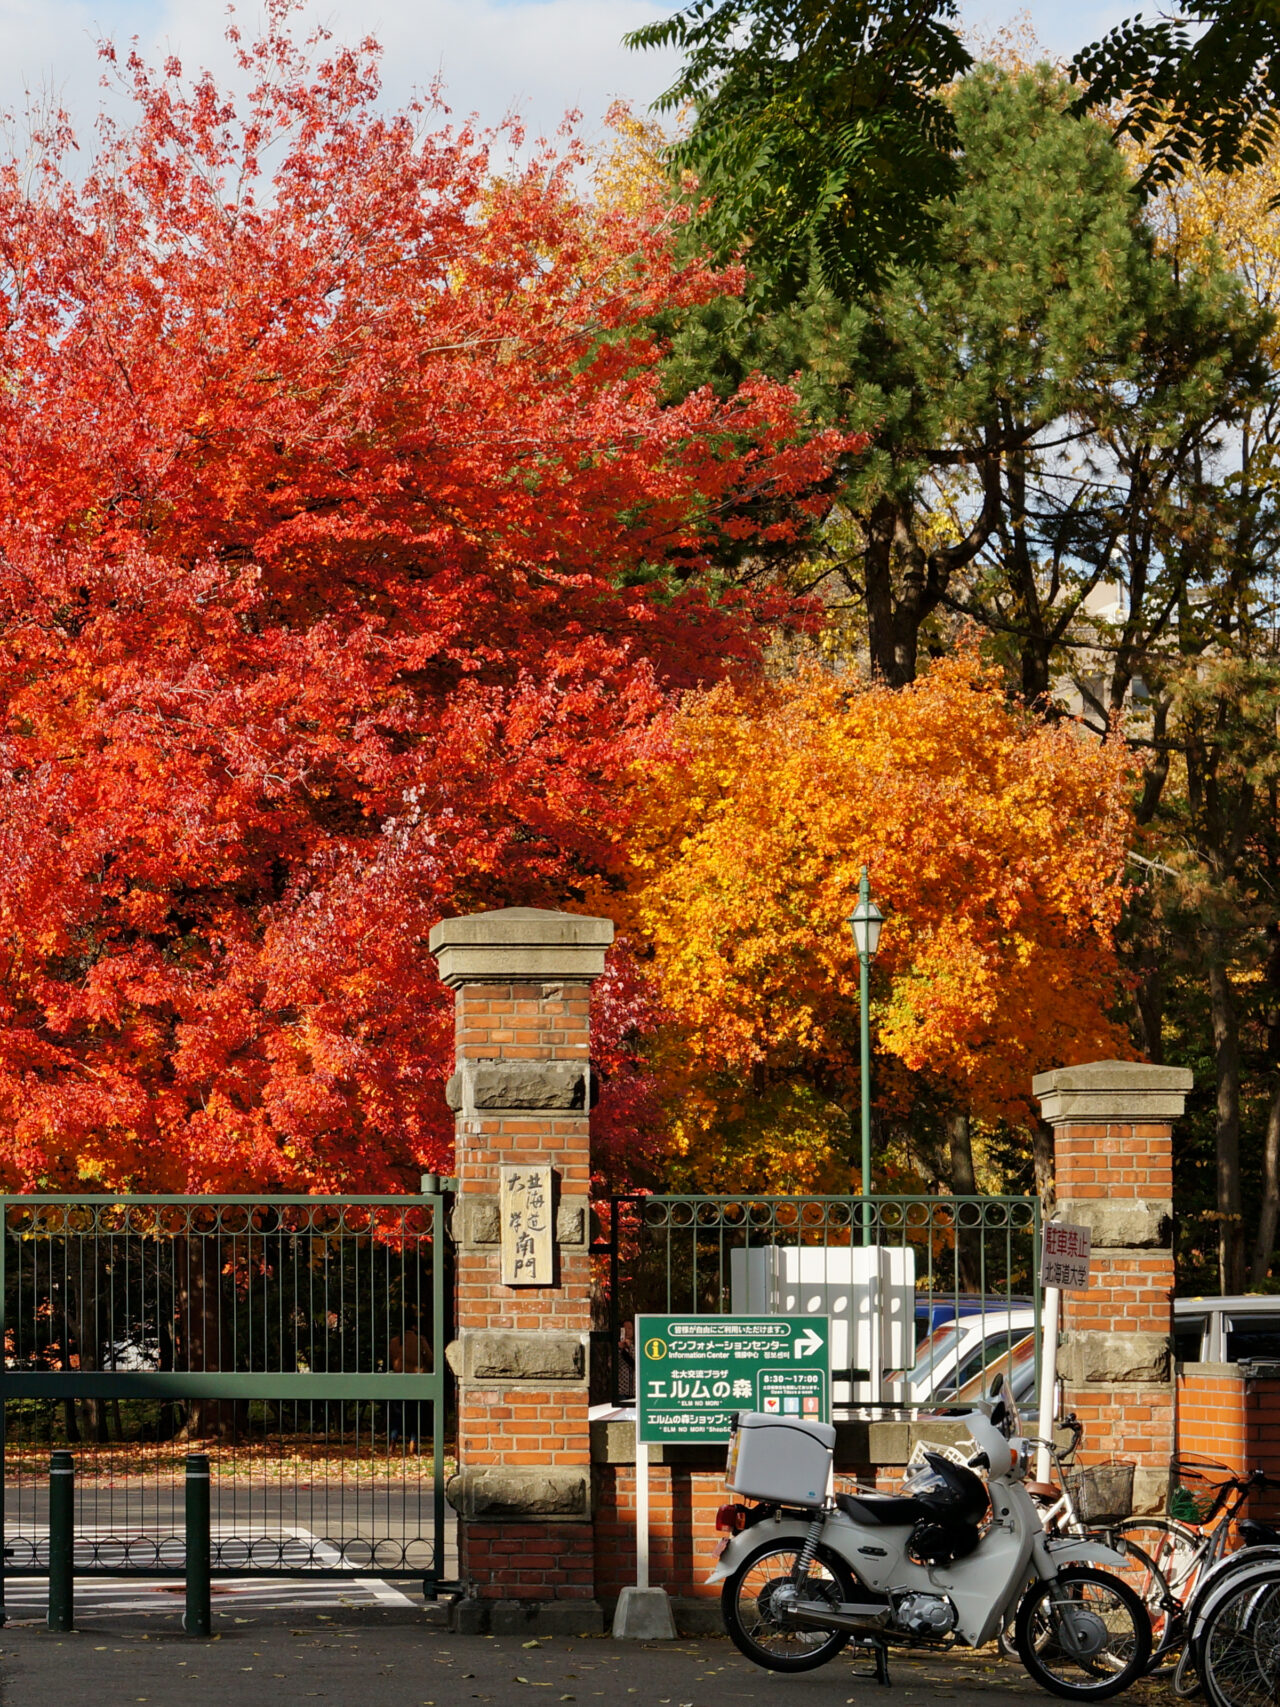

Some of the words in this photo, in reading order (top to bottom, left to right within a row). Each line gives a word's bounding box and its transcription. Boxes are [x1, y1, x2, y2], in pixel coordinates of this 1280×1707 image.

[1046, 1226, 1088, 1258] 駐車禁止
[514, 1232, 537, 1279] 南門
[1044, 1260, 1087, 1287] 北海道大学
[674, 1325, 786, 1335] 皆様が自由にご利用いただけます。
[668, 1340, 789, 1351] インフォメーションセンター
[668, 1351, 706, 1359] Information
[706, 1351, 730, 1359] Center
[671, 1369, 729, 1378] 北大交流プラザ
[647, 1378, 753, 1399] エルムの森
